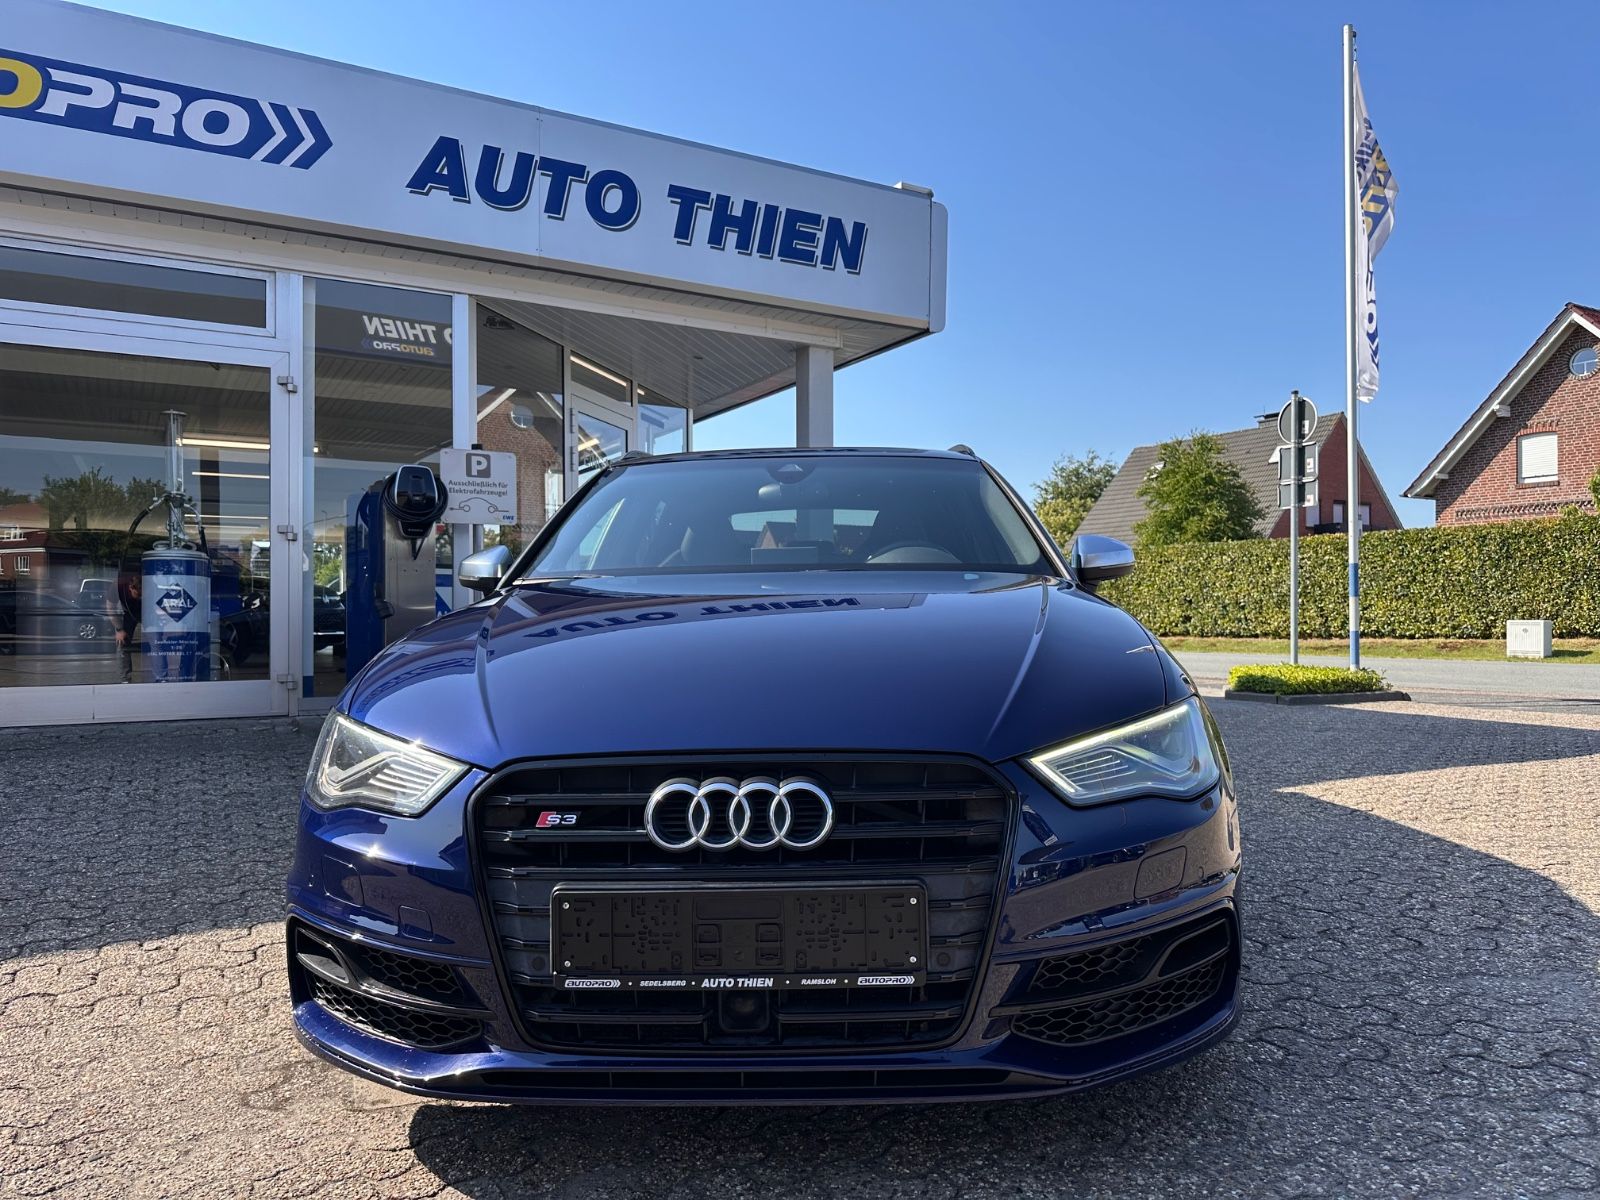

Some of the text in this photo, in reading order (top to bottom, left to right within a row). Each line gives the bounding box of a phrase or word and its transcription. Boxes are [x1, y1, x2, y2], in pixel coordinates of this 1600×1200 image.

[406, 135, 869, 274] AUTO THIEN
[471, 455, 488, 476] P
[448, 480, 508, 489] Ausschließlich für
[160, 598, 193, 608] ARAL
[544, 813, 578, 826] S3
[564, 976, 907, 988] AUTOPRO SEDELSBERG AUTO THIEN RAMSLOH AUTOPRO
